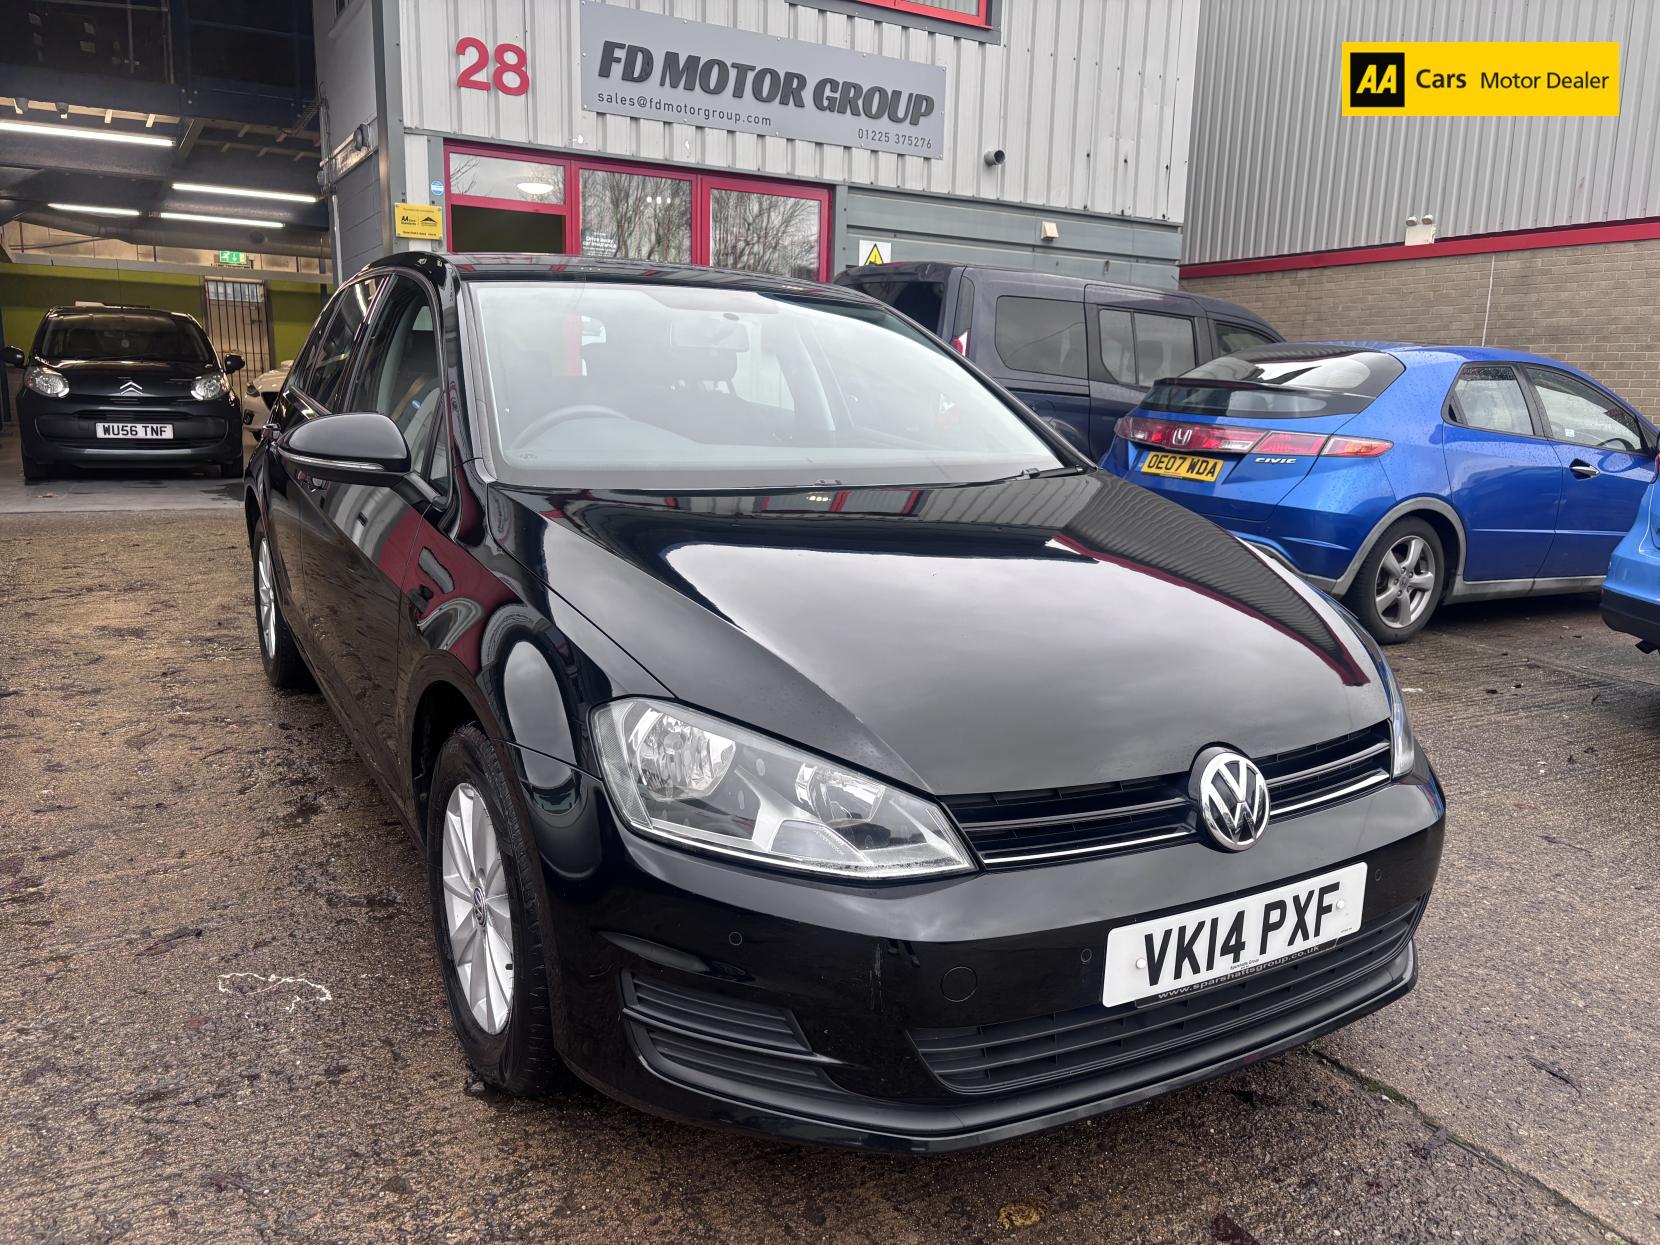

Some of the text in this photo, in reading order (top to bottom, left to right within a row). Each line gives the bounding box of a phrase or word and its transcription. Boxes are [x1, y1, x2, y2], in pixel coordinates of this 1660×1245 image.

[455, 36, 530, 97] 28
[598, 40, 936, 126] FD MOTOR GROUP
[597, 91, 772, 127] sales@fdmotorgroup.com
[857, 128, 933, 150] 01225 375276
[102, 424, 168, 438] WU56 TNF
[1147, 454, 1219, 478] OE07 WDA
[1144, 881, 1341, 987] VK14 PXF
[1157, 945, 1320, 999] www.sparshattsgroup.co.uk
